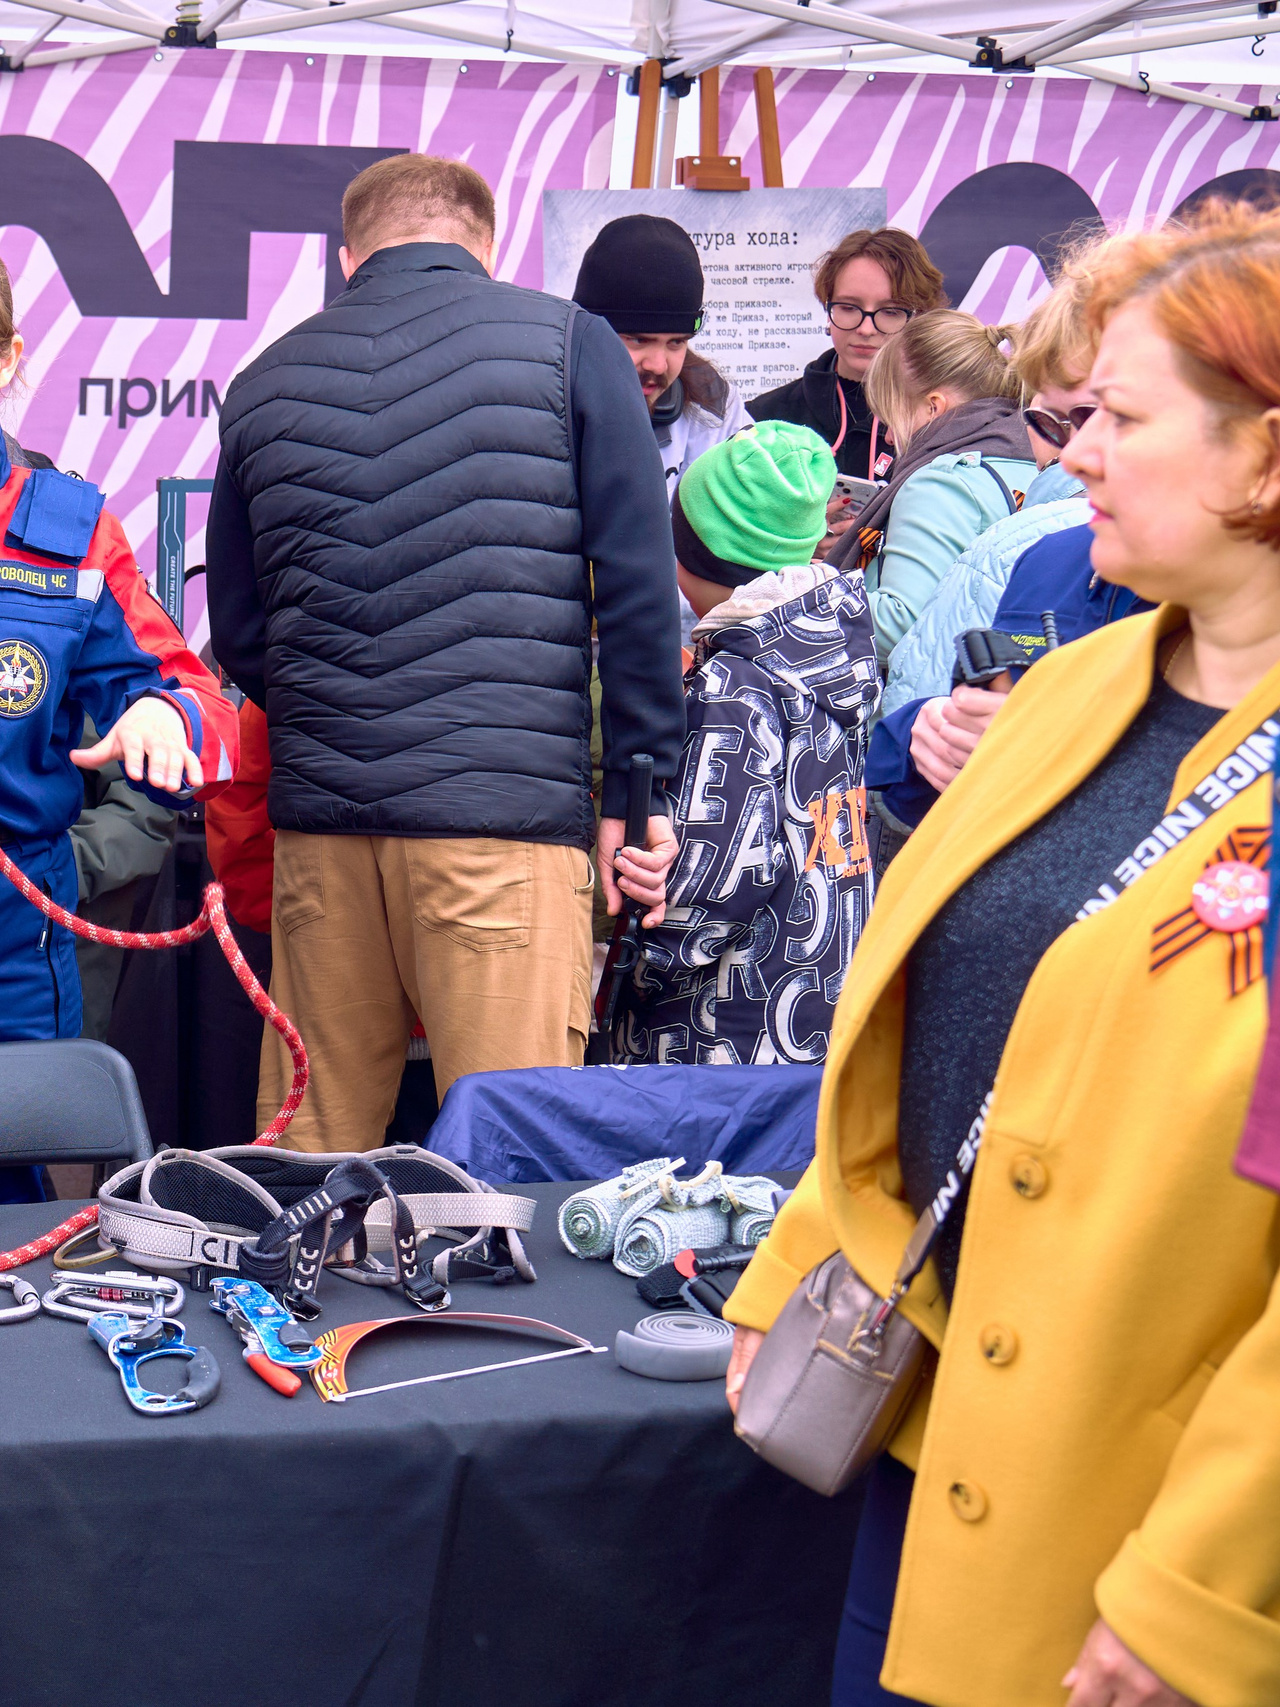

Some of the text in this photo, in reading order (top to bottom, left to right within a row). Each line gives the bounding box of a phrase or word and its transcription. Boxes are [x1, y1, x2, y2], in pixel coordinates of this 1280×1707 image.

[746, 231, 799, 248] хода:
[734, 262, 782, 273] активного
[711, 276, 795, 287] часовой стрелке.
[734, 300, 782, 311] приказов.
[732, 313, 769, 323] Приказ,
[774, 312, 812, 323] который
[715, 330, 742, 338] ходу,
[695, 341, 790, 352] выбранном Приказе.
[763, 364, 799, 374] врагов.
[51, 574, 67, 588] ЧС
[1113, 800, 1206, 888] NICE
